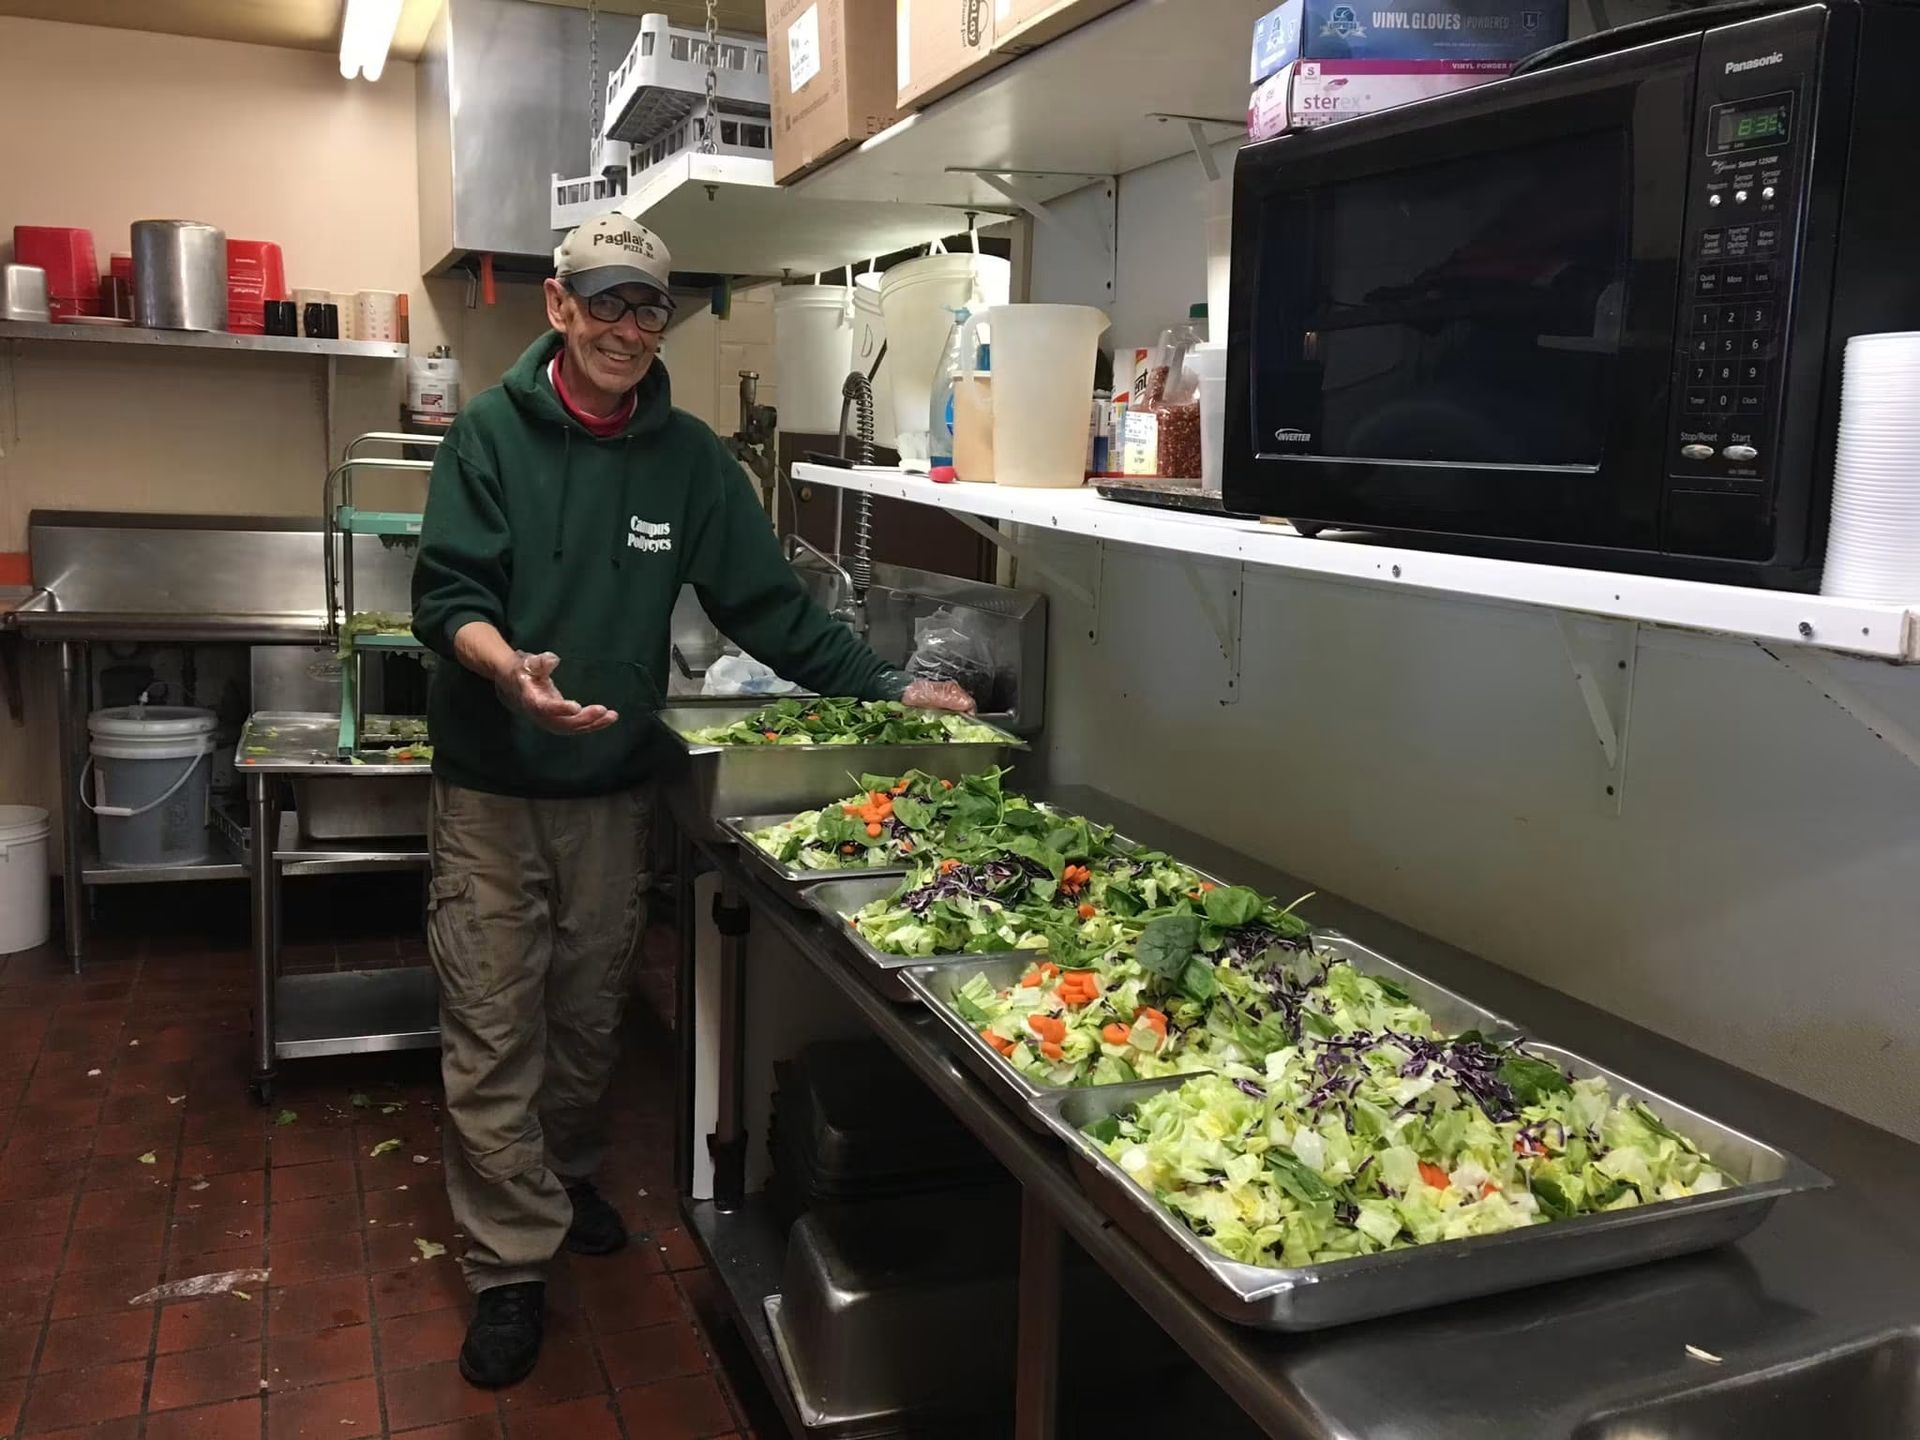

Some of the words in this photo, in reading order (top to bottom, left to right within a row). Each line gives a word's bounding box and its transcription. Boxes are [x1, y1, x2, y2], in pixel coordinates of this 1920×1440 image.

[1372, 11, 1410, 29] VINYL
[1411, 11, 1461, 30] GLOVES
[1725, 51, 1784, 75] Panasonic
[1307, 66, 1315, 76] S
[1303, 94, 1361, 110] sterex
[1727, 312, 1735, 323] 2
[1755, 310, 1762, 321] 3
[1698, 340, 1706, 351] 4
[1725, 340, 1732, 351] 5
[1752, 339, 1759, 349] 6
[1697, 368, 1704, 378] 7
[1722, 368, 1729, 378] 8
[1749, 367, 1756, 378] 9
[1720, 395, 1727, 405] 0
[1277, 432, 1311, 442] INVERTER
[1680, 432, 1718, 442] Stop/Reset
[1731, 432, 1751, 442] Start
[630, 515, 671, 537] Campus
